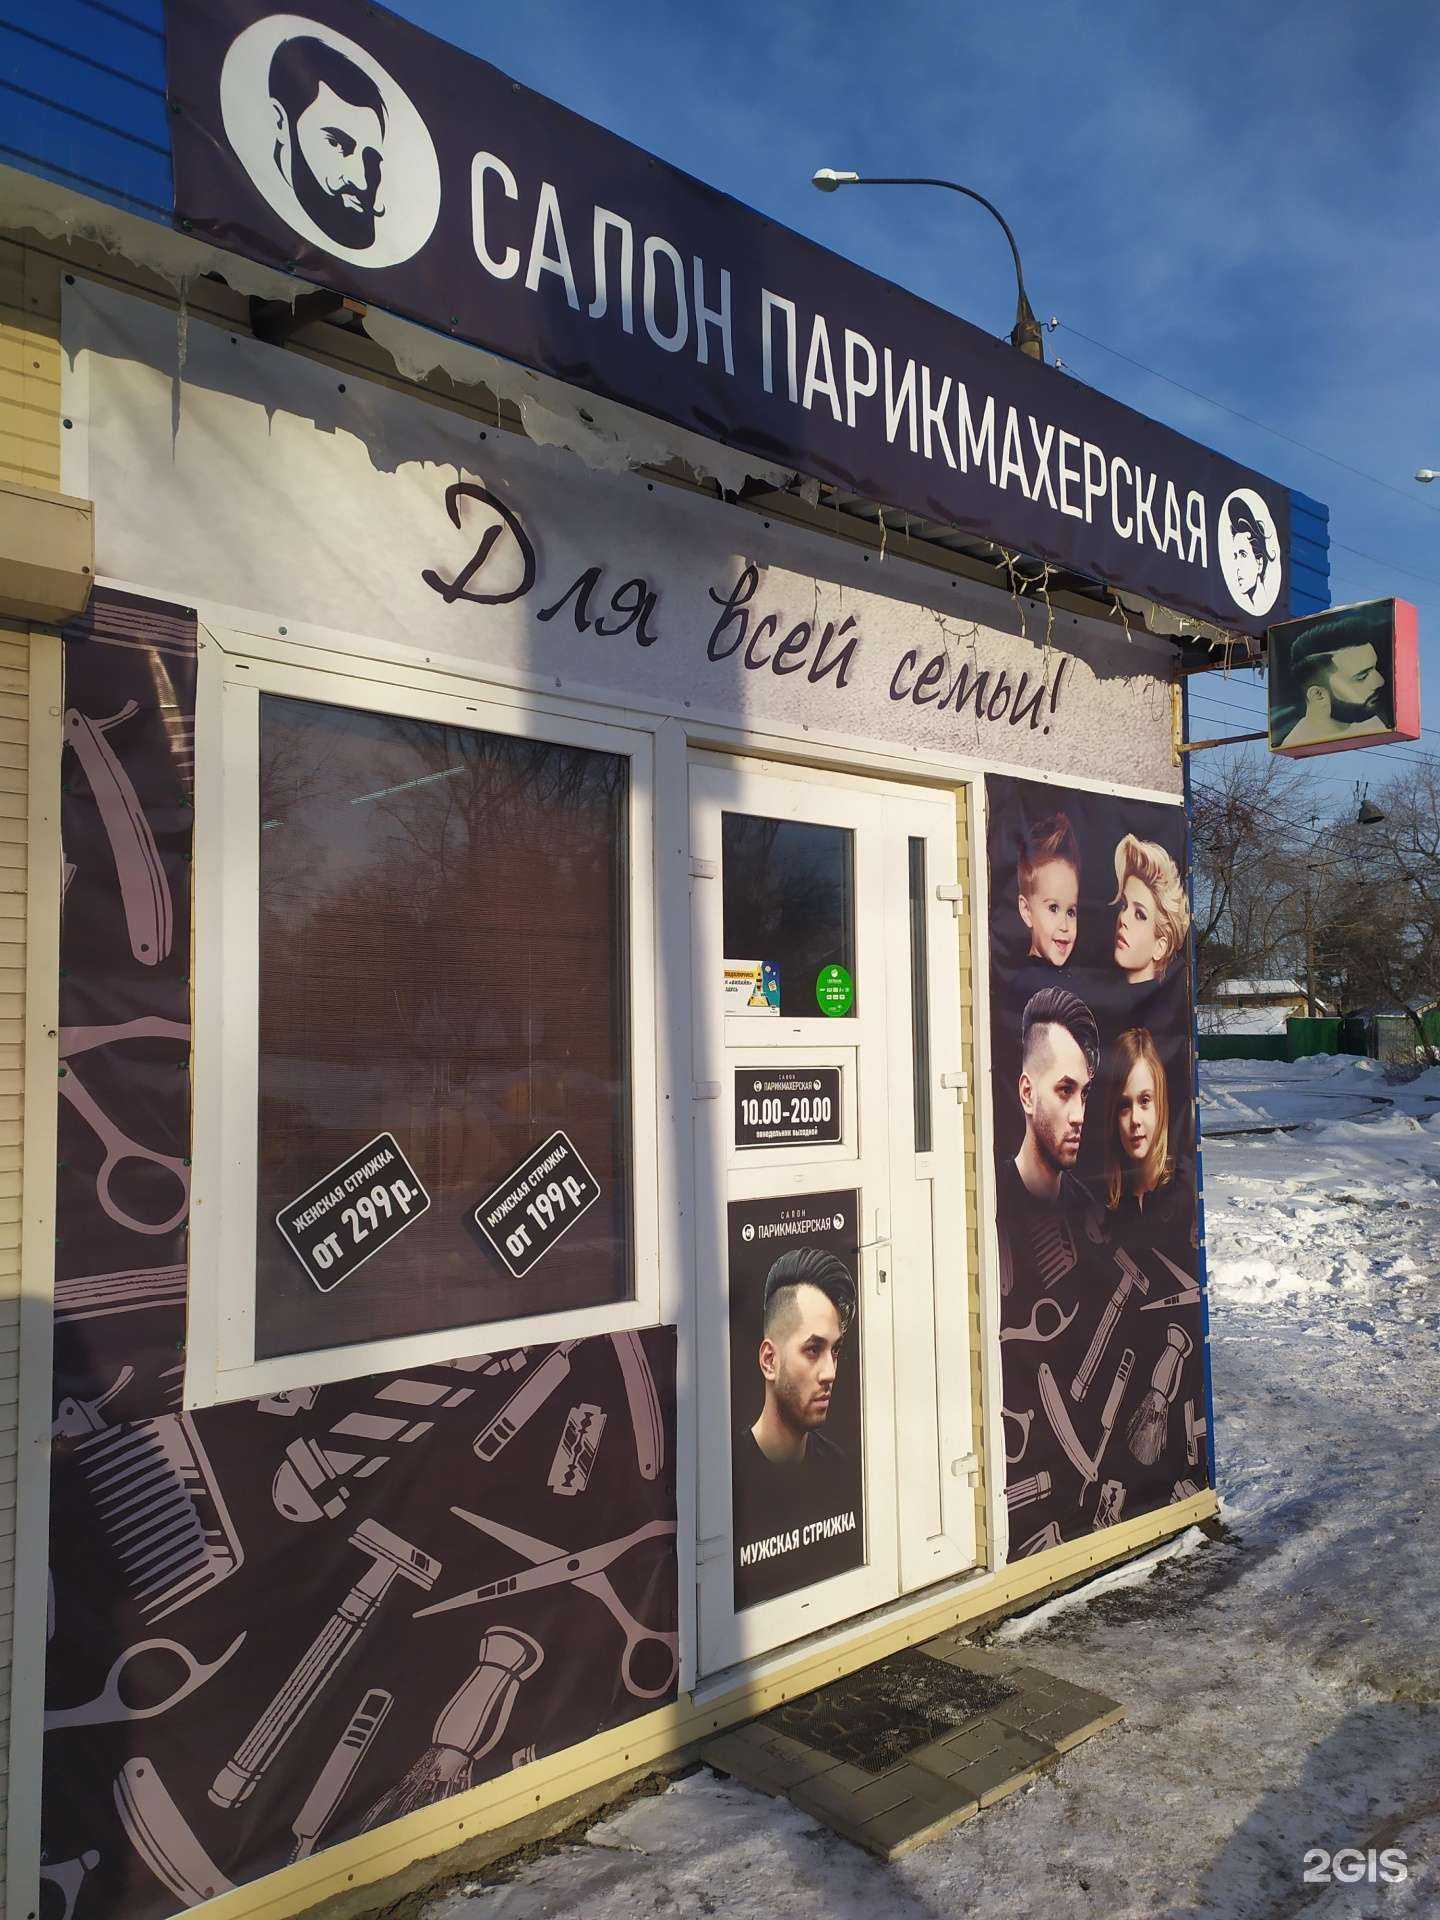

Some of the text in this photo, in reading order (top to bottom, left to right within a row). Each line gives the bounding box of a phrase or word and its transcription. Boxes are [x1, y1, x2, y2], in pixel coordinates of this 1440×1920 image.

[470, 150, 1208, 569] САЛОН ПАРИКМАХЕРСКАЯ
[421, 482, 1067, 736] Для всей семьи!
[763, 1081, 813, 1091] ПАРИКМАХЕРСКАЯ
[741, 1097, 831, 1125] 10.00-20.00
[292, 1149, 395, 1234] ЖЕНСКАЯ СТРИЖКА
[486, 1145, 568, 1228] МУЖСКАЯ СТРИЖКА
[758, 1217, 831, 1239] ПАРИКМАХЕРСКАЯ
[780, 1209, 806, 1219] САЛОН
[312, 1231, 344, 1269] от
[505, 1224, 532, 1258] от
[740, 1511, 856, 1567] МУЖСКАЯ СТРИЖКА
